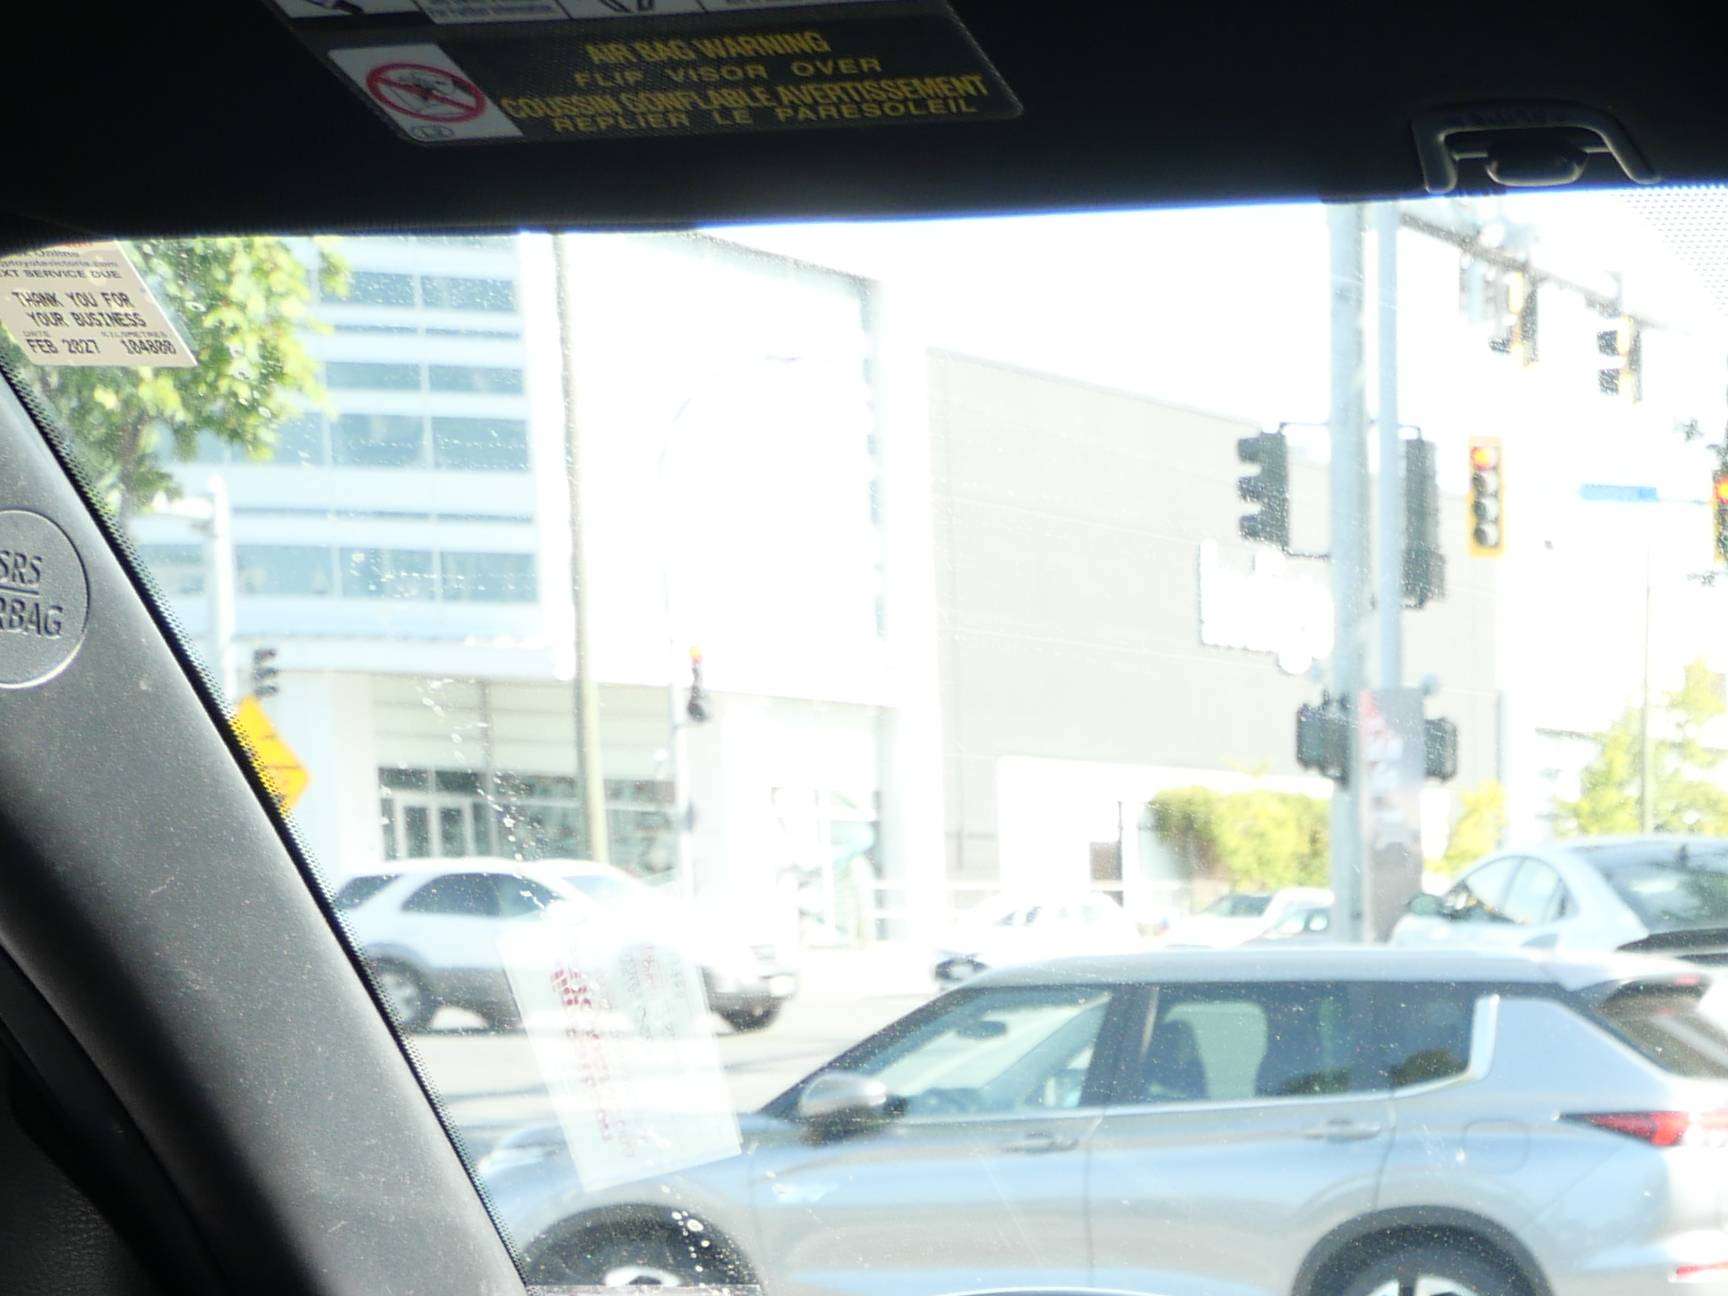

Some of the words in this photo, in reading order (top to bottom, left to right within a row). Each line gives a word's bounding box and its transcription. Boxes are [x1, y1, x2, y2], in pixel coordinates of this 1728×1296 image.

[585, 42, 637, 64] AIR
[637, 38, 695, 62] BAG
[694, 30, 831, 60] WARNING
[574, 70, 646, 88] FLIP
[664, 62, 768, 83] VISOR
[789, 56, 882, 78] OVER
[501, 94, 620, 120] COUSSIN
[775, 74, 989, 107] AVERTISSEMENT
[553, 111, 692, 134] REPLIER
[712, 110, 753, 126] LE
[777, 98, 978, 122] PARESOLEIL
[23, 269, 86, 279] SERVICE
[12, 291, 64, 309] THANK
[65, 291, 99, 309] YOU
[100, 291, 135, 309] FOR
[26, 311, 69, 328] YOUR
[70, 311, 147, 328] BUSINESS
[27, 338, 59, 355] FEB
[0, 549, 43, 585] SRS
[0, 596, 64, 638] RBAG
